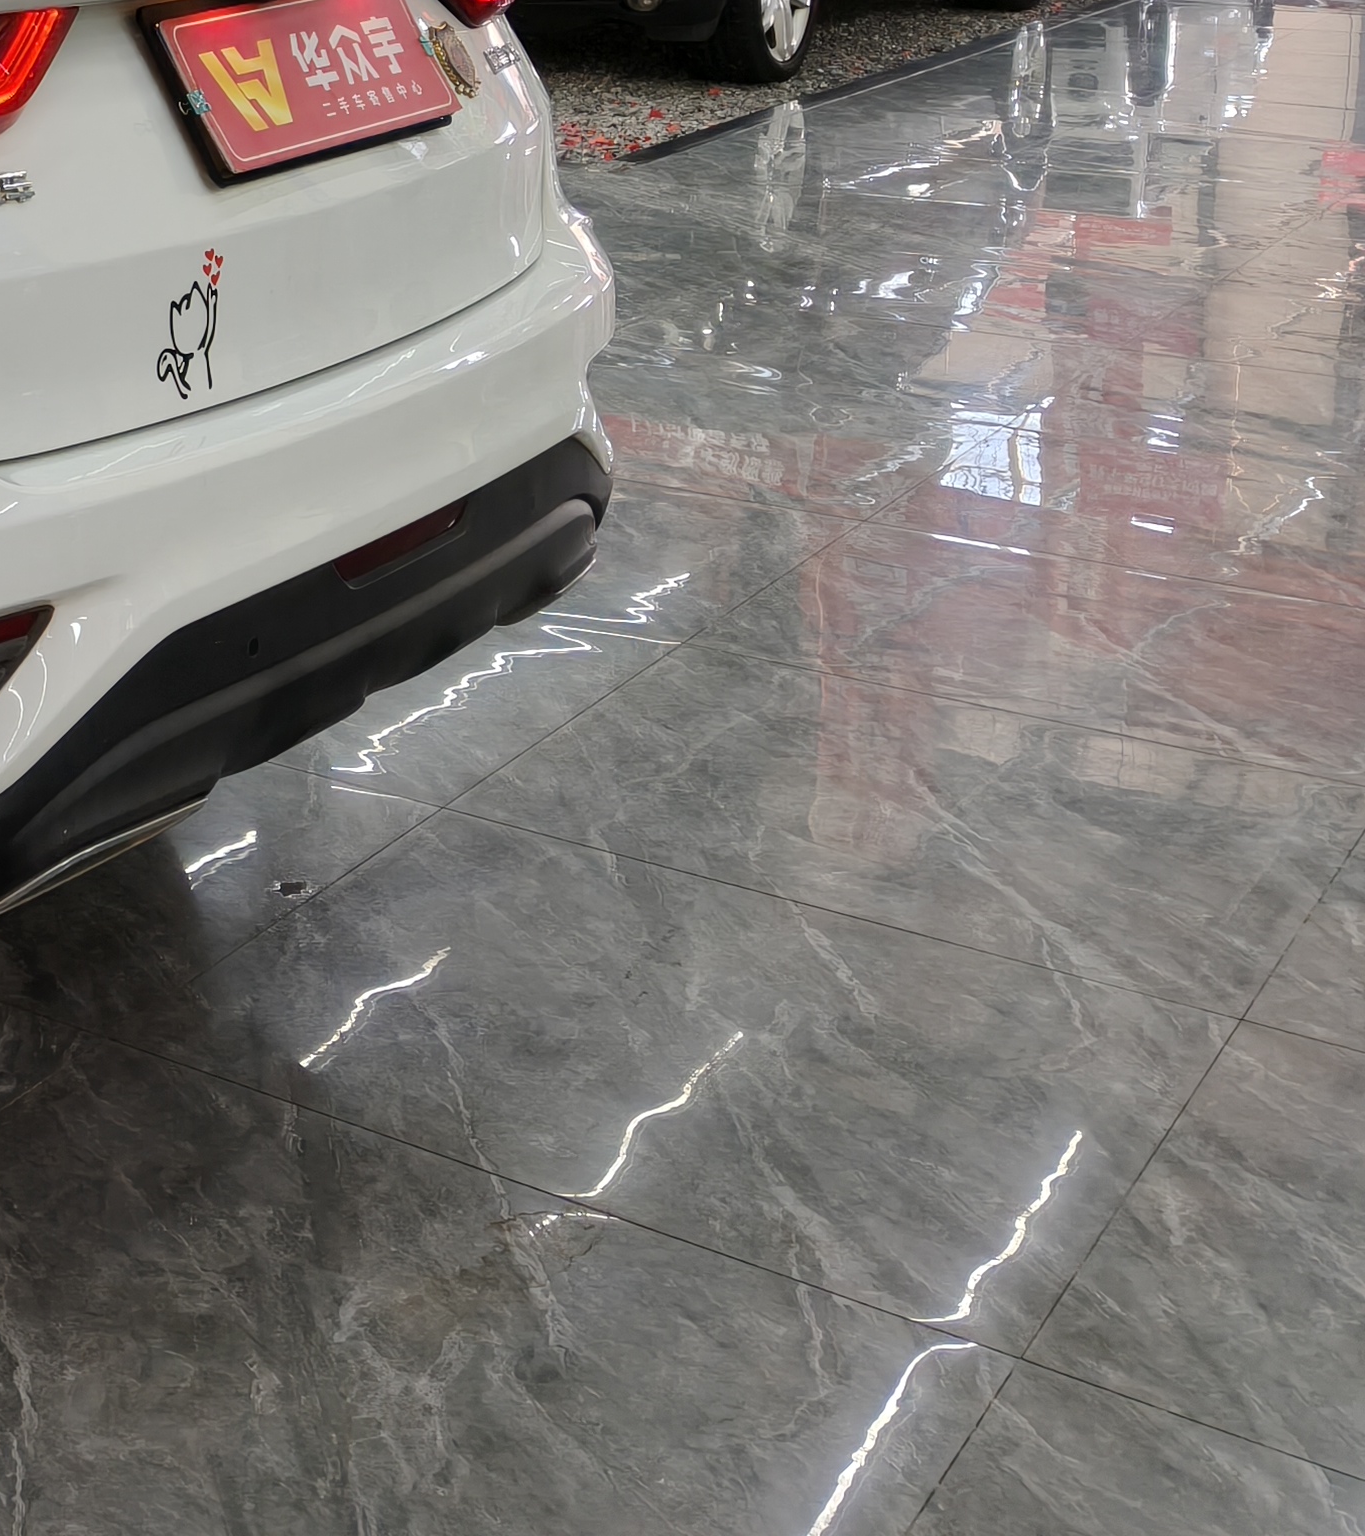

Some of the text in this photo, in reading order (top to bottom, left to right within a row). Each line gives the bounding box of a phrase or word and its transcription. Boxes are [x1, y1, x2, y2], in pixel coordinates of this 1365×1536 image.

[289, 16, 405, 91] 华众宇
[322, 80, 423, 117] 二手车寄售中心
